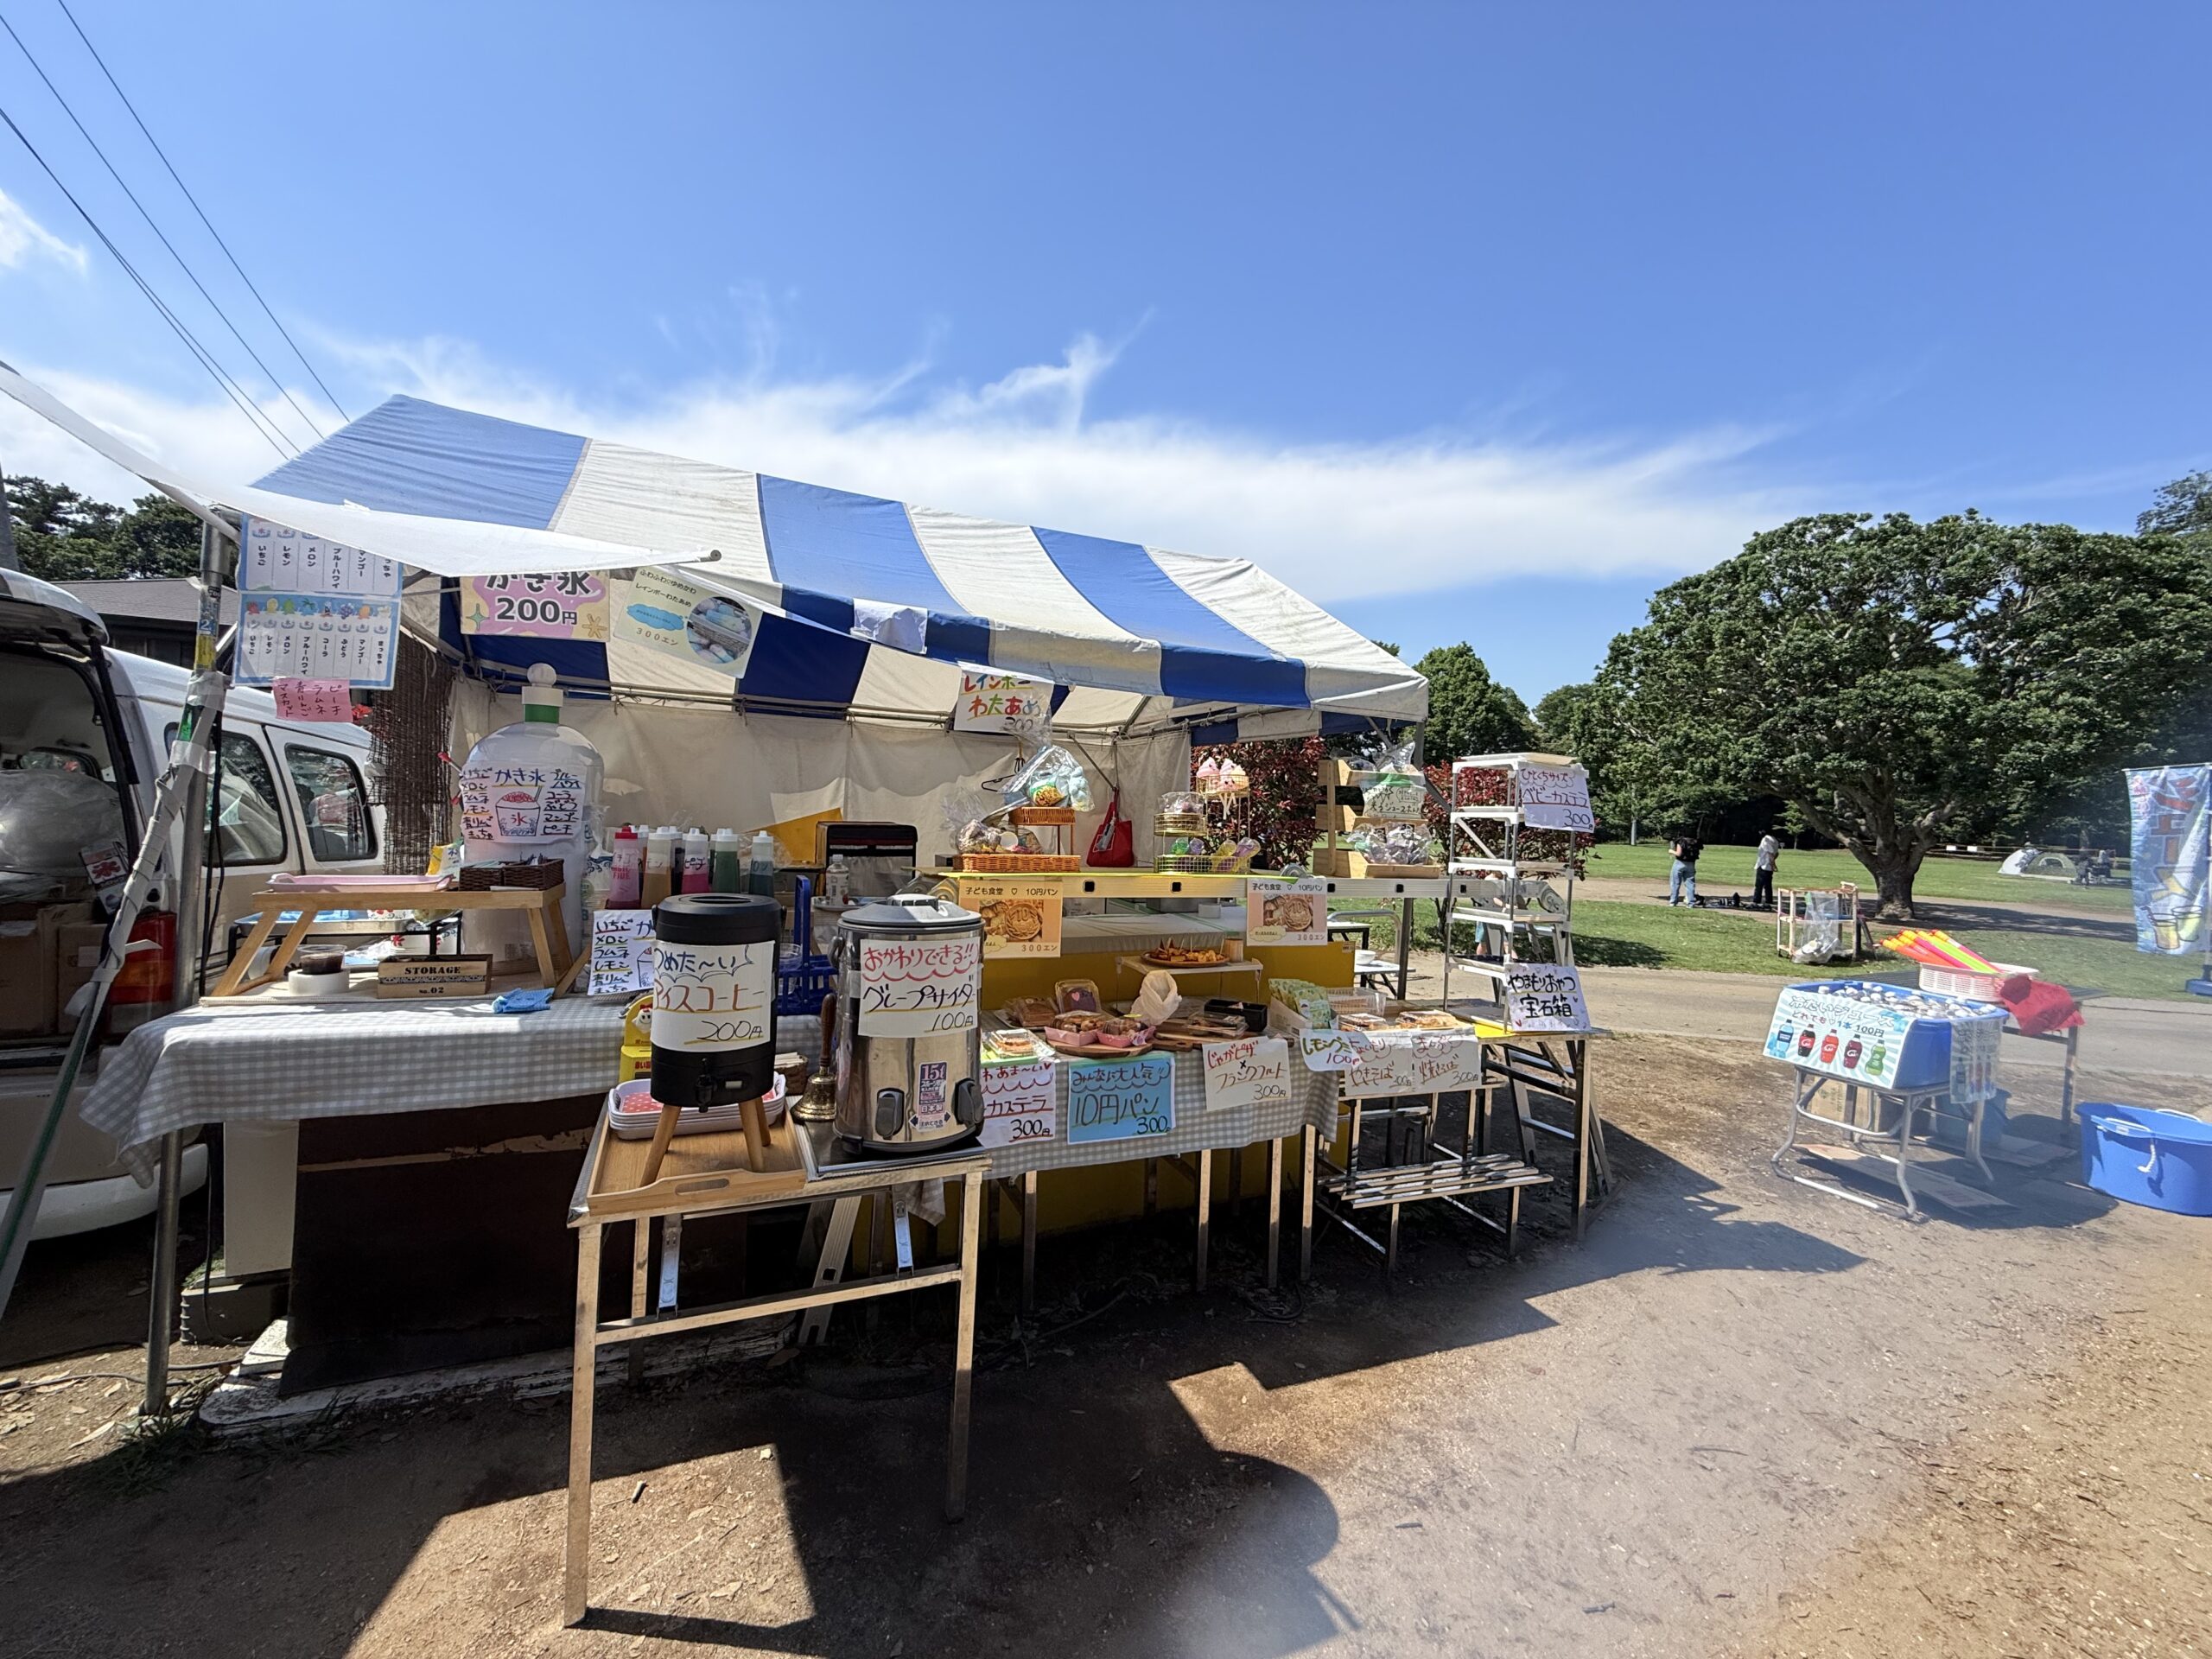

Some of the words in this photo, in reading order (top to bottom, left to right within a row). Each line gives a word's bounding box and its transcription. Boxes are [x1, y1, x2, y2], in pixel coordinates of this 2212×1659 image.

[257, 545, 267, 566] いちご
[282, 545, 291, 566] レモン
[307, 547, 316, 567] メロン
[357, 550, 366, 577] マンゴー
[332, 548, 342, 588] ブルーハワイ
[383, 558, 391, 578] っちゃ
[635, 582, 692, 607] レインボーわたあめ
[497, 597, 577, 625] 200円
[301, 636, 311, 675] ブルーハワイ
[312, 684, 327, 715] ラムネ
[329, 684, 342, 715] ピーチ
[968, 694, 1040, 717] わたあめ
[494, 767, 546, 787] かき氷
[1522, 786, 1587, 806] ベビーカステラ
[511, 811, 528, 826] 氷
[543, 824, 572, 835] ピーチ
[965, 887, 1003, 895] 子ども食堂
[1026, 887, 1058, 896] 10円パン
[1252, 882, 1282, 891] 子ども食堂
[596, 918, 633, 932] いちご
[594, 935, 629, 945] メロン
[594, 946, 630, 958] ラムネ
[404, 966, 461, 975] STORAGE
[594, 960, 630, 971] レモン
[593, 971, 633, 986] 青りんご
[1507, 972, 1576, 993] やまもりおやつ
[653, 978, 764, 1013] アイスコーヒー
[1519, 993, 1573, 1019] 宝石箱
[931, 1012, 974, 1031] 100円
[1789, 995, 1894, 1027] 冷たいジュース
[696, 1020, 762, 1042] 200円
[1792, 1010, 1827, 1025] どれでも
[1855, 1025, 1885, 1038] 100円
[1207, 1039, 1259, 1069] じゃがピザ
[1302, 1036, 1352, 1056] レモングミ
[1215, 1061, 1287, 1094] フランクフルト
[1350, 1060, 1395, 1086] やきそば
[1419, 1053, 1459, 1082] 焼きそば
[1394, 1075, 1412, 1086] 00円
[1253, 1084, 1287, 1101] 300円
[984, 1095, 1046, 1116] カステラ
[1075, 1092, 1160, 1126] 10円パン
[1010, 1118, 1051, 1140] 300円
